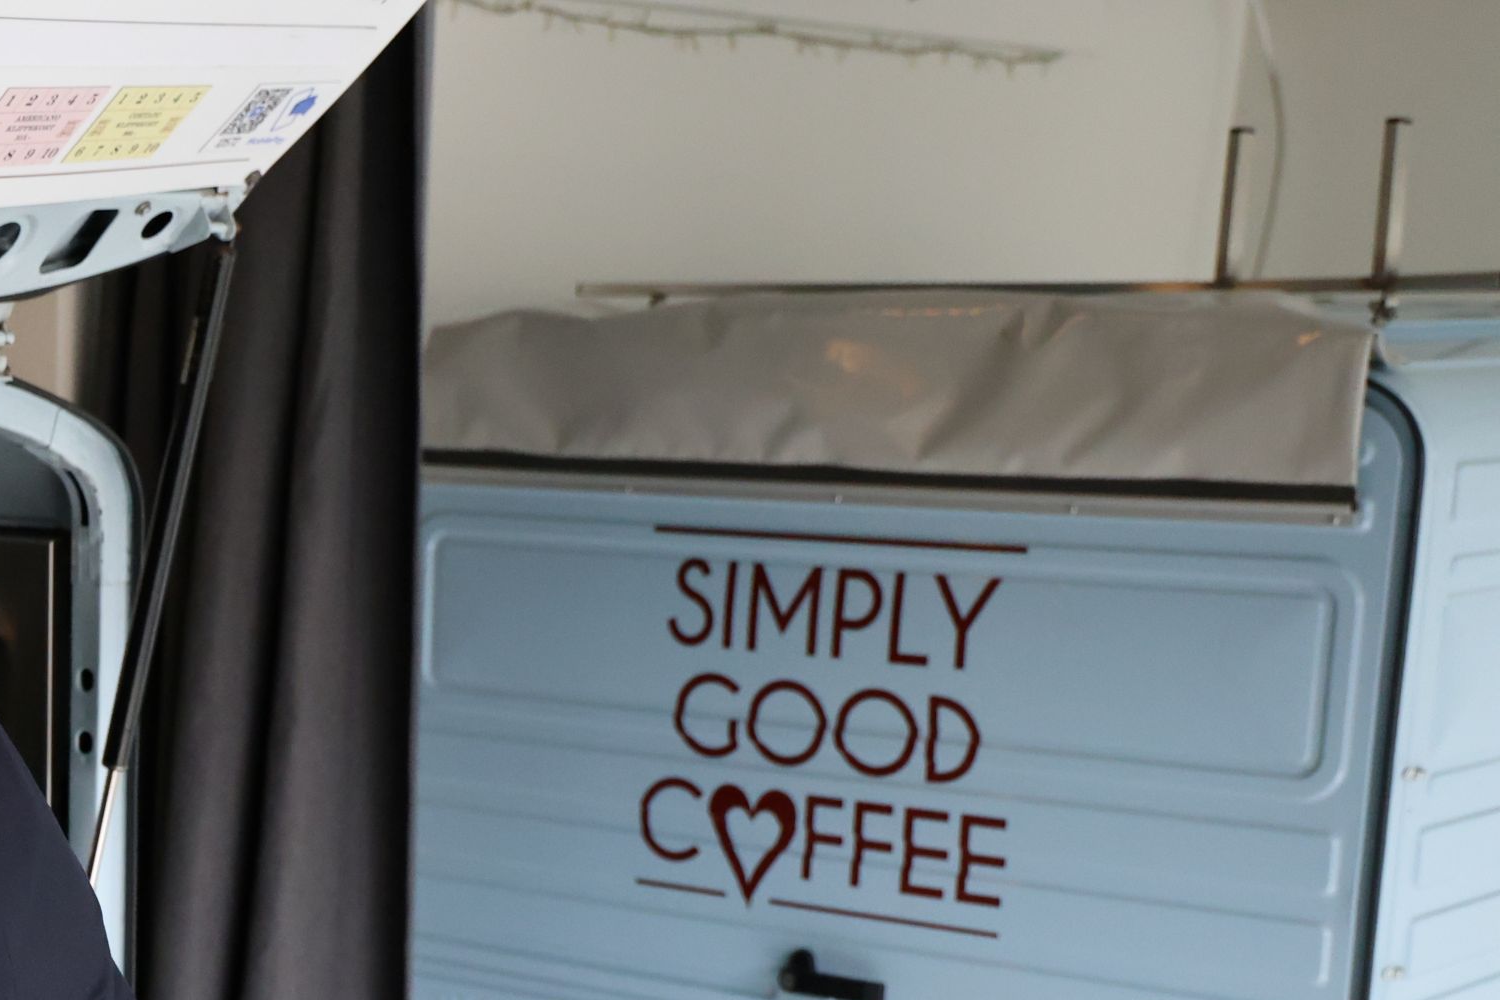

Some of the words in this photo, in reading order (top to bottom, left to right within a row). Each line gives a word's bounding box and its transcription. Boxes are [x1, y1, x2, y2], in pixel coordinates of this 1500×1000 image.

[5, 95, 16, 106] 1
[25, 95, 38, 106] 2
[46, 94, 59, 106] 3
[67, 95, 78, 105] 4
[86, 94, 99, 105] 5
[3, 150, 16, 161] 8
[24, 149, 36, 160] 9
[41, 148, 60, 159] 10
[667, 557, 1002, 669] SIMPLY
[674, 672, 980, 784] GOOD
